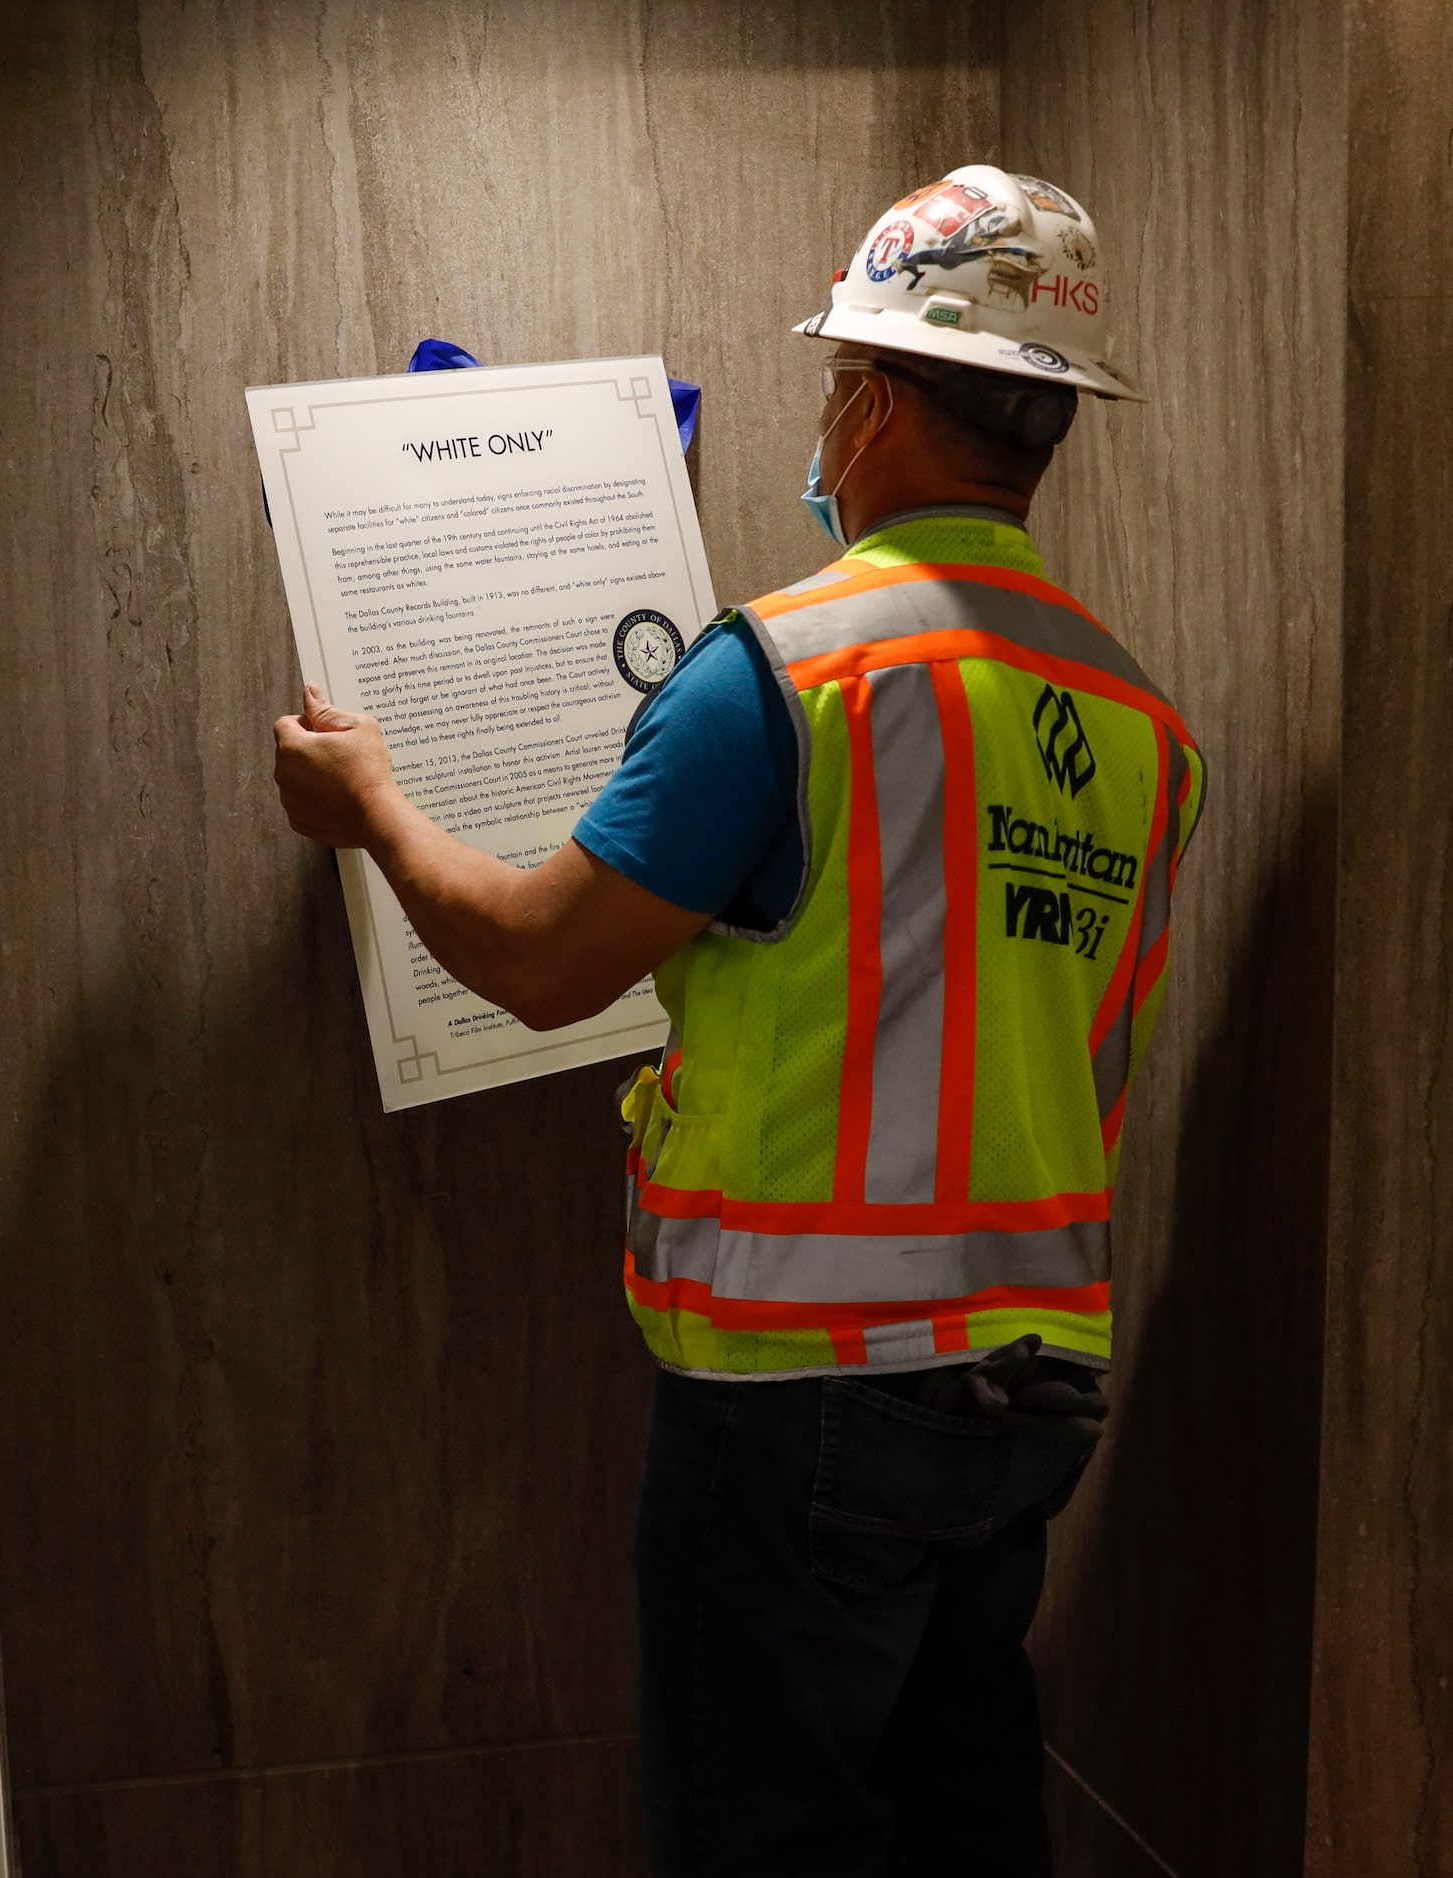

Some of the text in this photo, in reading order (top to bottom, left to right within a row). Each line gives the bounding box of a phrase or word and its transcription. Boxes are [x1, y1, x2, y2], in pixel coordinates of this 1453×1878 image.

[1031, 274, 1098, 315] HKS
[928, 309, 957, 322] MSA
[324, 511, 345, 520] While
[368, 507, 377, 515] be
[378, 504, 402, 514] difficult
[403, 503, 412, 511] for
[440, 495, 475, 507] understand
[476, 494, 496, 503] today,
[497, 493, 513, 502] signs
[514, 490, 543, 498] enforcing
[543, 486, 561, 495] racial
[562, 484, 603, 493] discrimination
[603, 481, 612, 490] by
[612, 479, 646, 488] designating
[328, 524, 356, 534] separate
[357, 521, 384, 530] facilities
[385, 519, 394, 527] for
[446, 511, 459, 520] and
[532, 499, 562, 510] commonly
[563, 496, 584, 506] existed
[584, 494, 616, 504] throughout
[332, 547, 366, 557] Beginning
[399, 540, 422, 550] quarter
[443, 534, 458, 542] 19th
[459, 533, 482, 541] century
[483, 529, 496, 538] and
[497, 527, 529, 536] continuing
[530, 523, 543, 532] until
[554, 520, 569, 529] Civil
[569, 519, 588, 529] Rights
[625, 511, 654, 521] abolished
[344, 611, 358, 620] The
[358, 609, 380, 618] Dallas
[380, 606, 404, 615] County
[405, 601, 432, 611] Records
[432, 599, 461, 608] Building,
[462, 595, 476, 604] built
[486, 591, 506, 600] 1913,
[530, 585, 558, 595] different,
[558, 582, 571, 591] and
[610, 577, 626, 586] signs
[626, 572, 647, 582] existed
[647, 571, 666, 579] above
[360, 584, 396, 594] restaurants
[361, 645, 383, 656] 2003,
[409, 638, 436, 648] building
[454, 634, 473, 642] being
[475, 627, 508, 639] renovated,
[523, 622, 551, 632] remnants
[562, 617, 576, 626] such
[585, 616, 598, 625] sign
[619, 613, 646, 638] COUNTY
[355, 657, 391, 671] uncovered.
[393, 656, 409, 665] After
[410, 652, 428, 662] much
[428, 650, 463, 660] discussion,
[475, 643, 496, 653] Dallas
[496, 641, 518, 650] County
[519, 634, 565, 646] Commissioners
[565, 631, 583, 639] Court
[583, 628, 601, 637] chose
[358, 675, 382, 685] expose
[383, 670, 397, 680] and
[398, 669, 426, 680] preserve
[439, 662, 466, 672] remnant
[483, 654, 508, 666] original
[508, 652, 535, 661] location.
[536, 649, 548, 657] The
[549, 646, 575, 655] decision
[589, 640, 607, 649] made
[627, 672, 648, 690] STATE
[425, 758, 437, 767] 15,
[438, 754, 460, 765] 2013,
[460, 753, 472, 761] the
[472, 750, 493, 759] Dallas
[494, 746, 517, 756] County
[518, 739, 565, 752] Commissioners
[565, 734, 583, 743] Court
[584, 729, 610, 740] unveiled
[525, 846, 536, 855] and
[539, 845, 548, 853] the
[411, 954, 428, 963] order
[414, 966, 440, 977] Drinking
[416, 980, 439, 991] woods,
[418, 988, 468, 1006] people together
[473, 1011, 495, 1021] Drinking
[450, 1030, 469, 1038] Tribeca
[471, 1027, 482, 1035] Film
